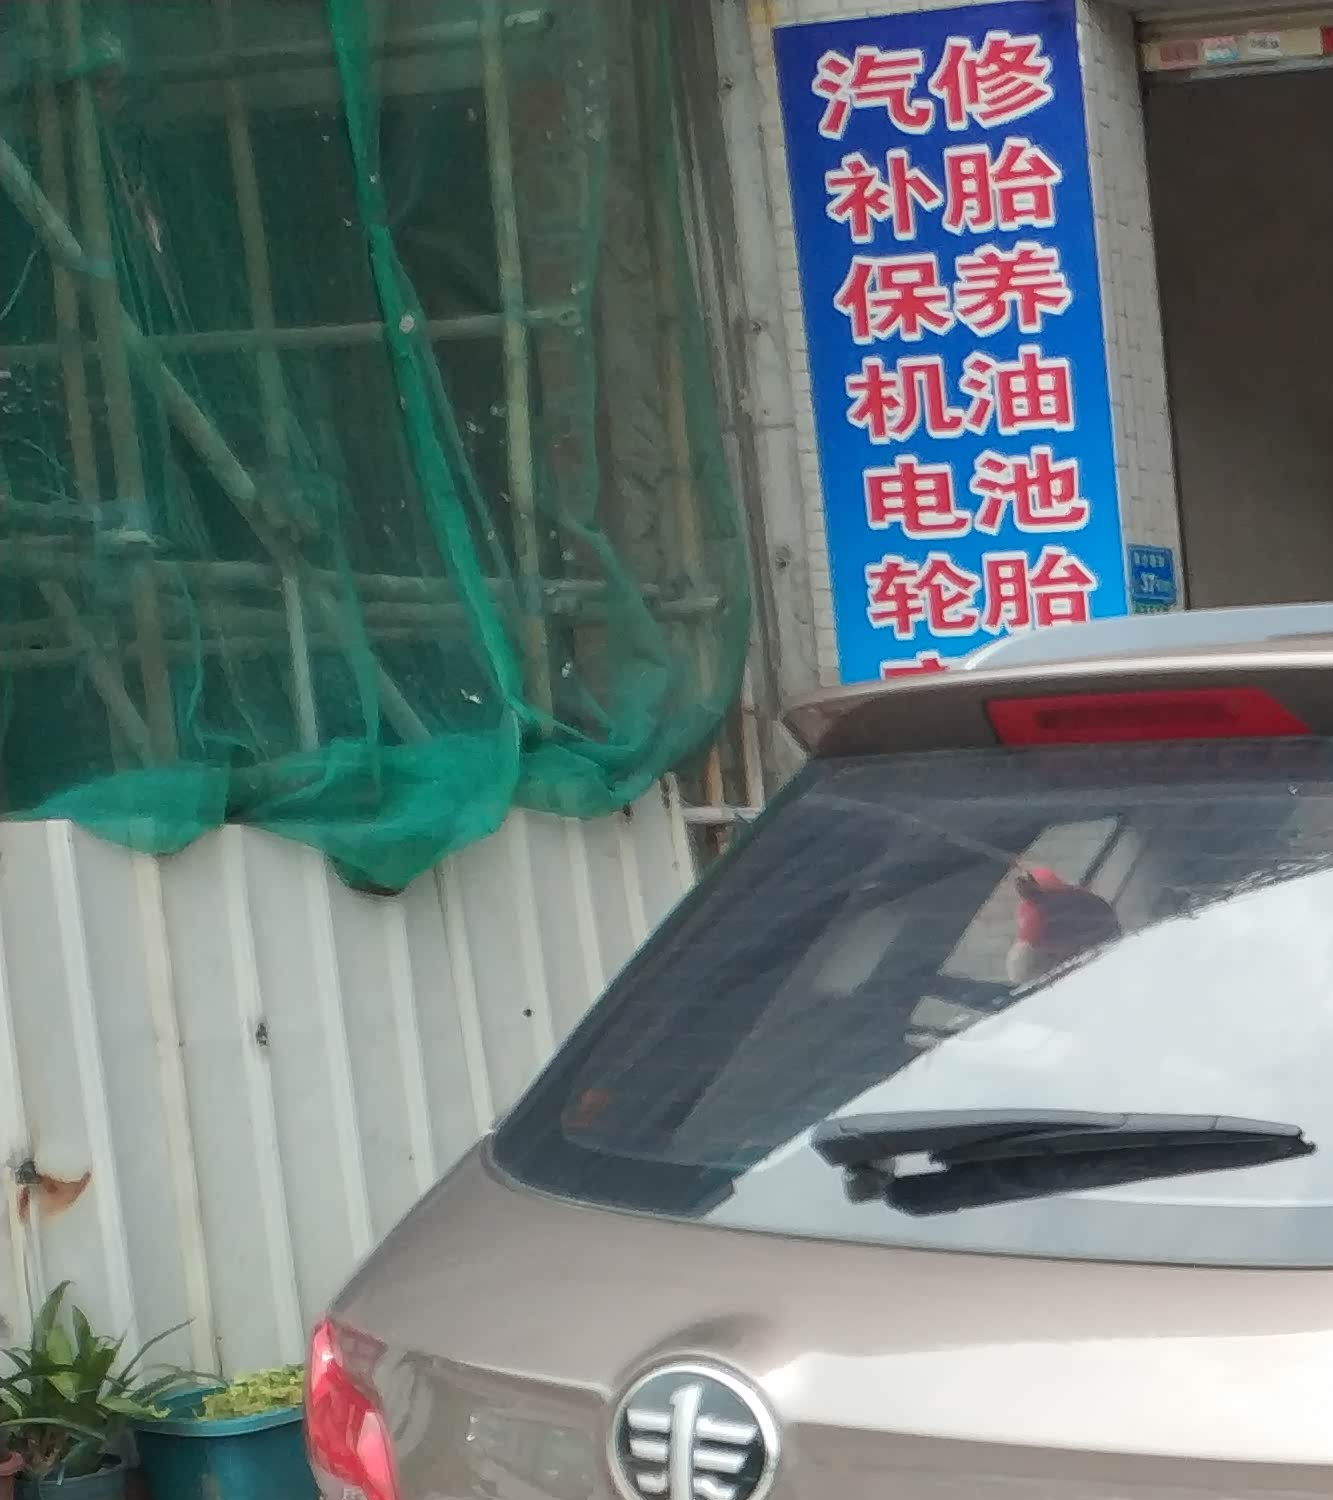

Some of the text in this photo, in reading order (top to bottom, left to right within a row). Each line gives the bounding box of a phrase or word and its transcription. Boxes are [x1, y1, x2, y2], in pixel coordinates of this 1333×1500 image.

[812, 31, 1053, 139] 汽修
[825, 138, 1062, 242] 补胎
[833, 243, 1072, 345] 保养
[846, 345, 1075, 443] 机油
[862, 446, 1090, 540] 电池
[866, 545, 1095, 639] 轮胎
